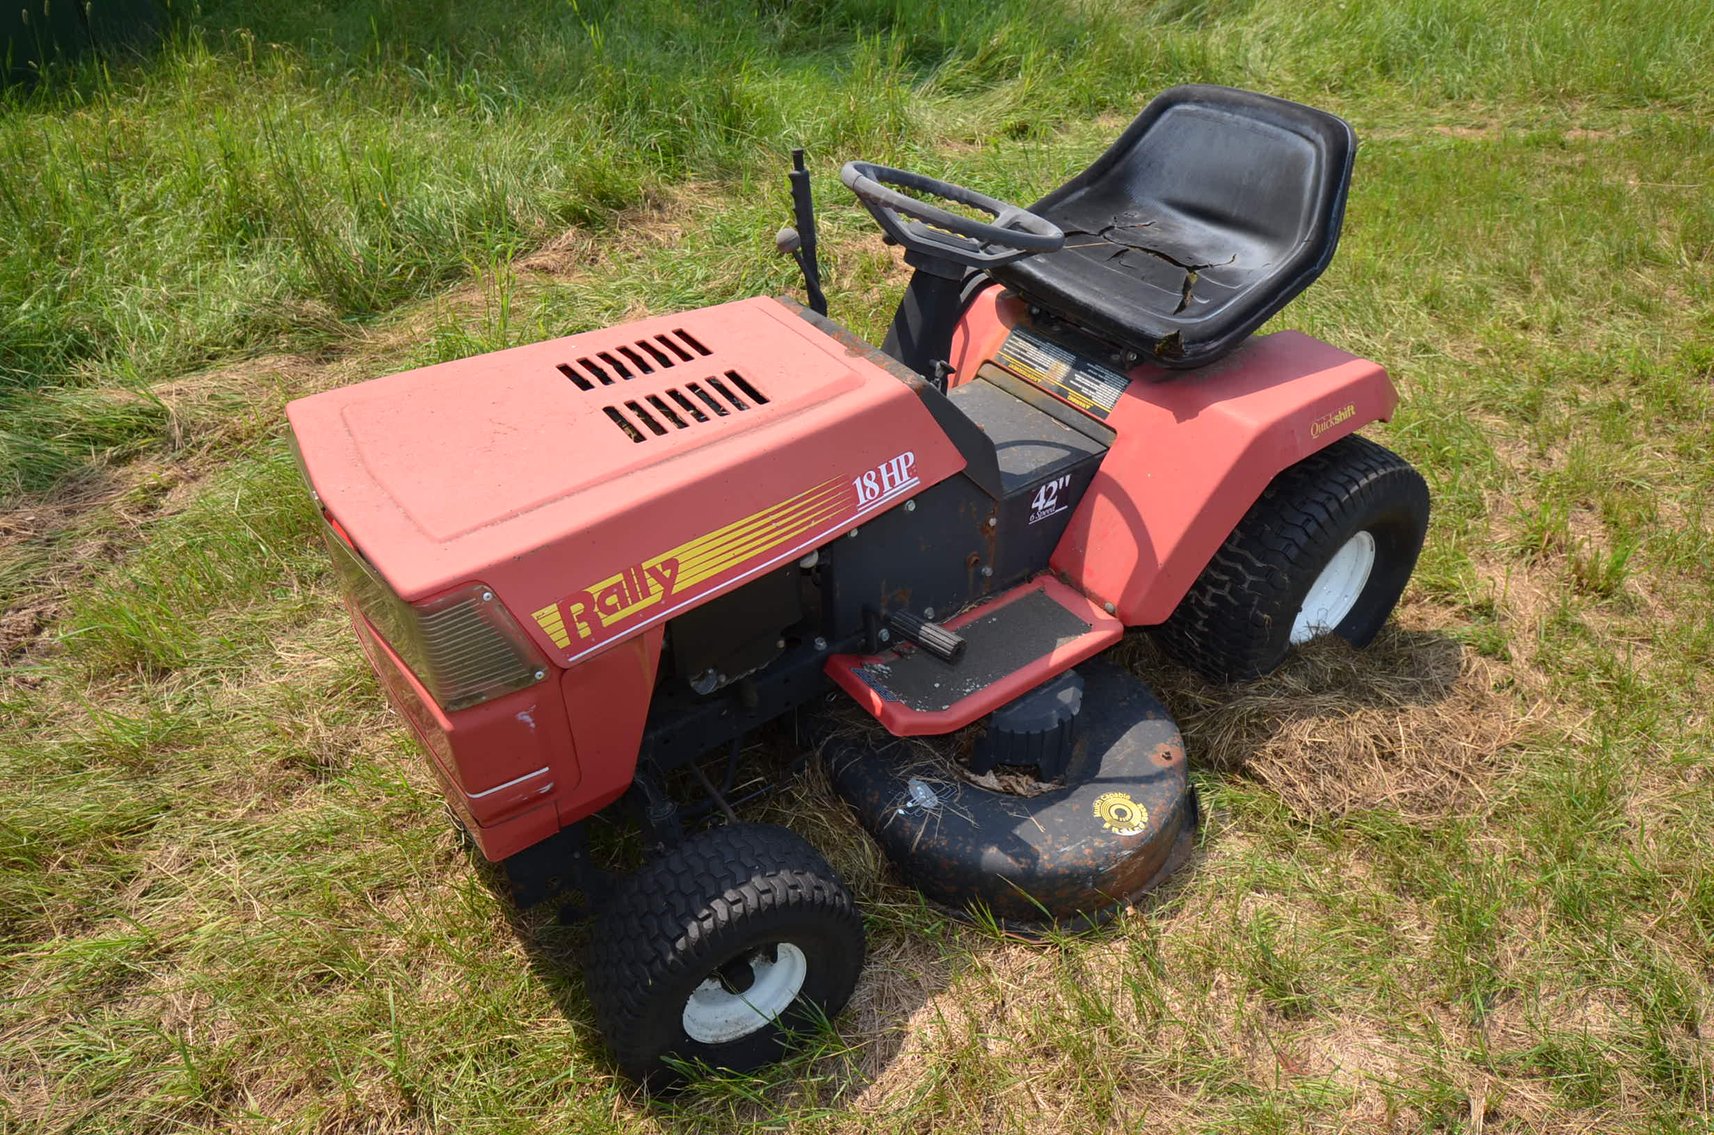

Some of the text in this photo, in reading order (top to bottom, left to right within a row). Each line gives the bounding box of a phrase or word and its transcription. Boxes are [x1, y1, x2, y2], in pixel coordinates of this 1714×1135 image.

[1310, 404, 1356, 439] Quickshift
[852, 451, 915, 507] 18 HP
[557, 556, 681, 647] Rally
